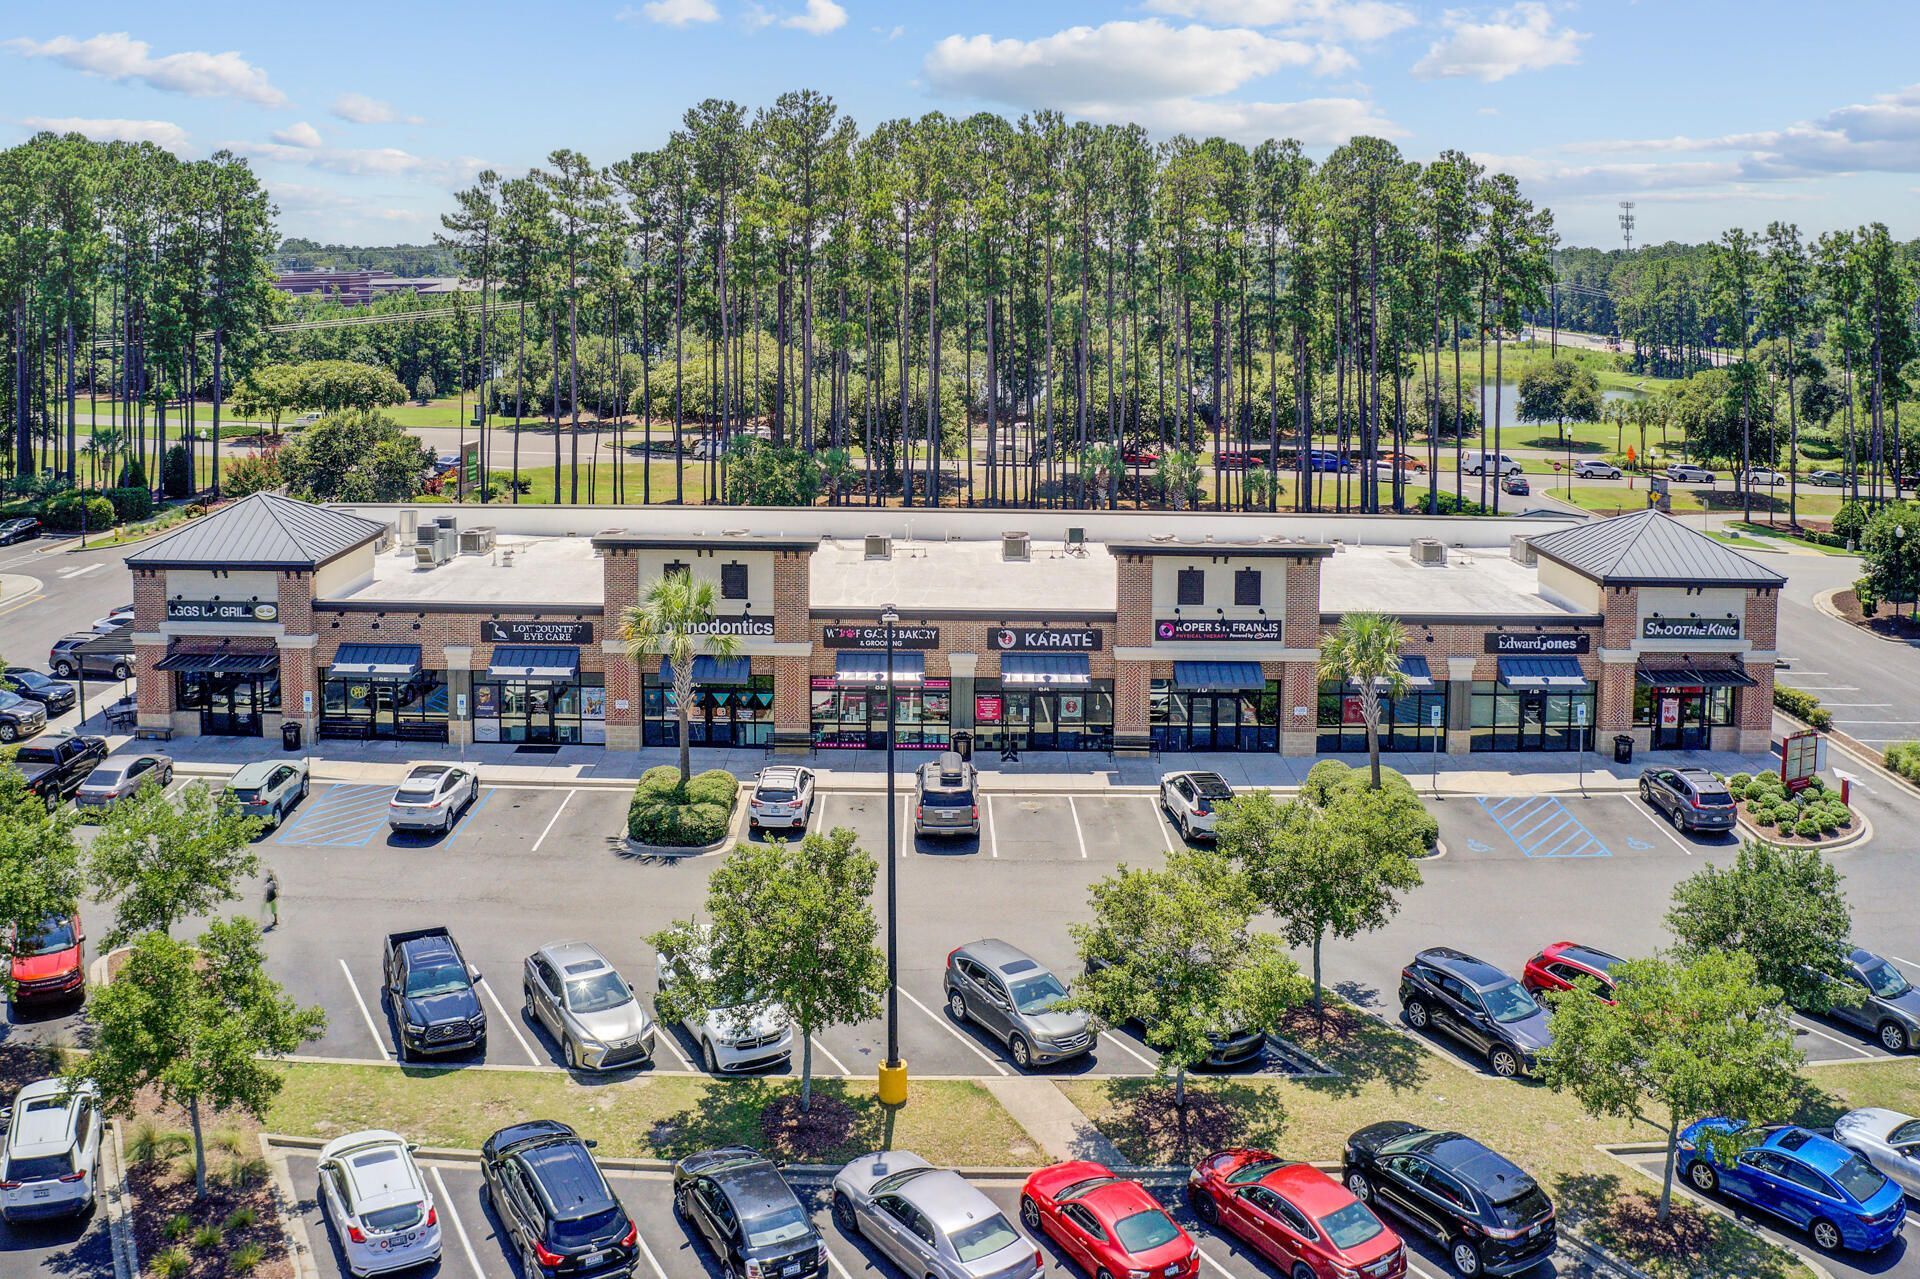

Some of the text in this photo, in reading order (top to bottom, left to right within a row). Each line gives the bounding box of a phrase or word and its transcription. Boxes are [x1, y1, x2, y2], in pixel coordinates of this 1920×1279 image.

[168, 606, 200, 616] EGGS
[663, 618, 774, 635] othodontics
[1176, 623, 1212, 632] ROPER
[1232, 623, 1279, 632] FRANCIS
[523, 633, 572, 641] EYE CARE
[899, 630, 937, 640] BAKRY
[1025, 633, 1093, 647] KARATE
